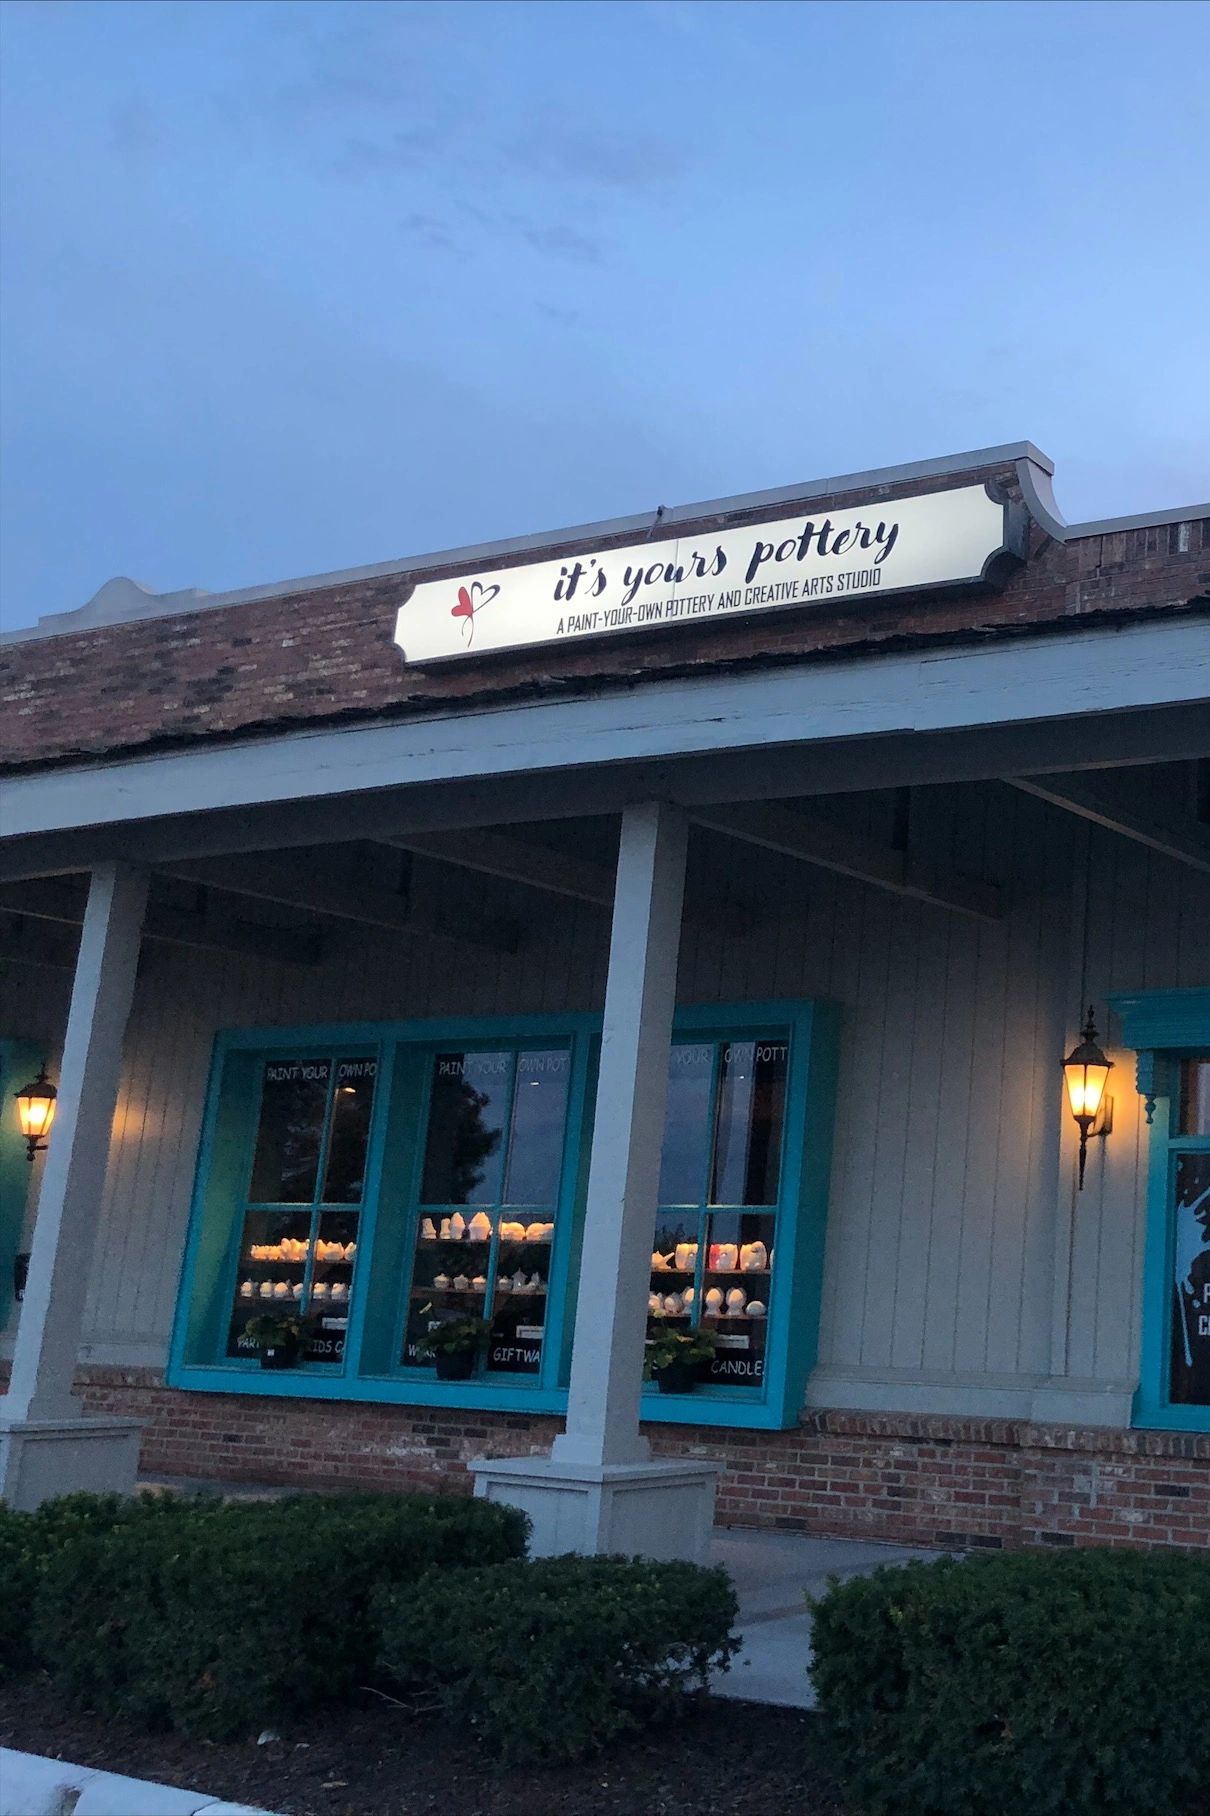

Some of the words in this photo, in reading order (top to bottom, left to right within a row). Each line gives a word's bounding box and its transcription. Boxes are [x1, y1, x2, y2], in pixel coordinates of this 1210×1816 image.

[554, 559, 607, 601] it's
[621, 545, 727, 606] yours
[745, 519, 899, 584] pottery
[556, 618, 564, 634] A
[567, 602, 662, 632] PAINT-YOUR-OWN
[665, 594, 715, 617] POTTERY
[717, 590, 741, 610] AND
[744, 580, 799, 605] CREATIVE
[801, 575, 834, 597] ARTS
[837, 568, 881, 591] STUDIO
